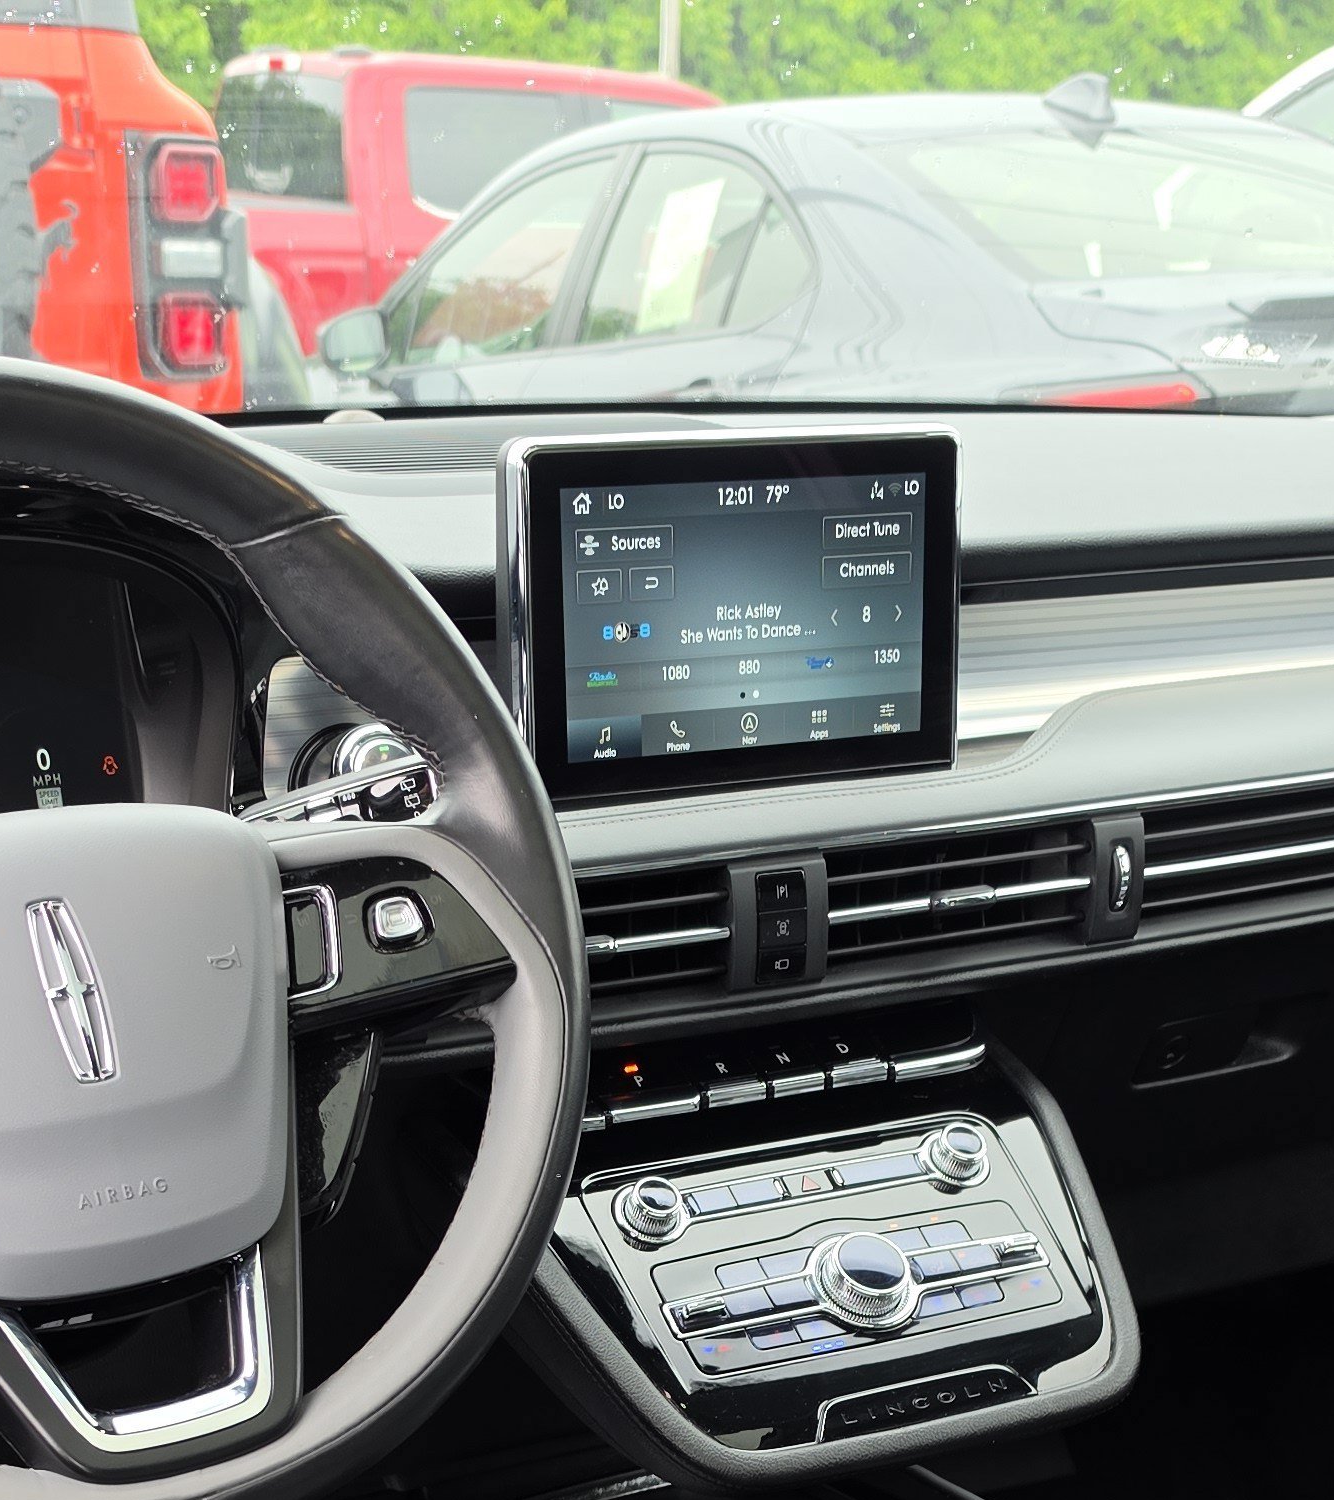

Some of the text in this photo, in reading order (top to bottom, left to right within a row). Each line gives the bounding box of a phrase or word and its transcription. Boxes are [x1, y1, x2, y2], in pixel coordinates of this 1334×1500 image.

[608, 493, 624, 510] LO
[717, 485, 753, 506] 12:01
[904, 479, 920, 496] LO
[835, 519, 900, 539] Direct Tune
[611, 533, 661, 551] Sources
[839, 560, 895, 579] Channels
[716, 602, 782, 621] Rick Astley
[862, 605, 871, 623] 8
[680, 628, 703, 645] She
[705, 626, 743, 643] Wants
[745, 625, 759, 642] To
[761, 622, 802, 640] Dance
[873, 648, 901, 665] 1350
[662, 664, 690, 682] 1080
[738, 659, 761, 676] 880
[809, 728, 829, 741] Apps
[873, 720, 902, 734] Settings
[666, 739, 691, 752] Phone
[741, 733, 758, 746] Nav
[36, 748, 51, 771] 0
[593, 746, 617, 759] Audio
[32, 772, 62, 787] MPH
[835, 1042, 850, 1055] D
[775, 1051, 791, 1065] N
[715, 1062, 729, 1075] R
[633, 1075, 644, 1087] P
[78, 1176, 168, 1211] AIRBAG
[840, 1378, 1008, 1425] LINCOLN
